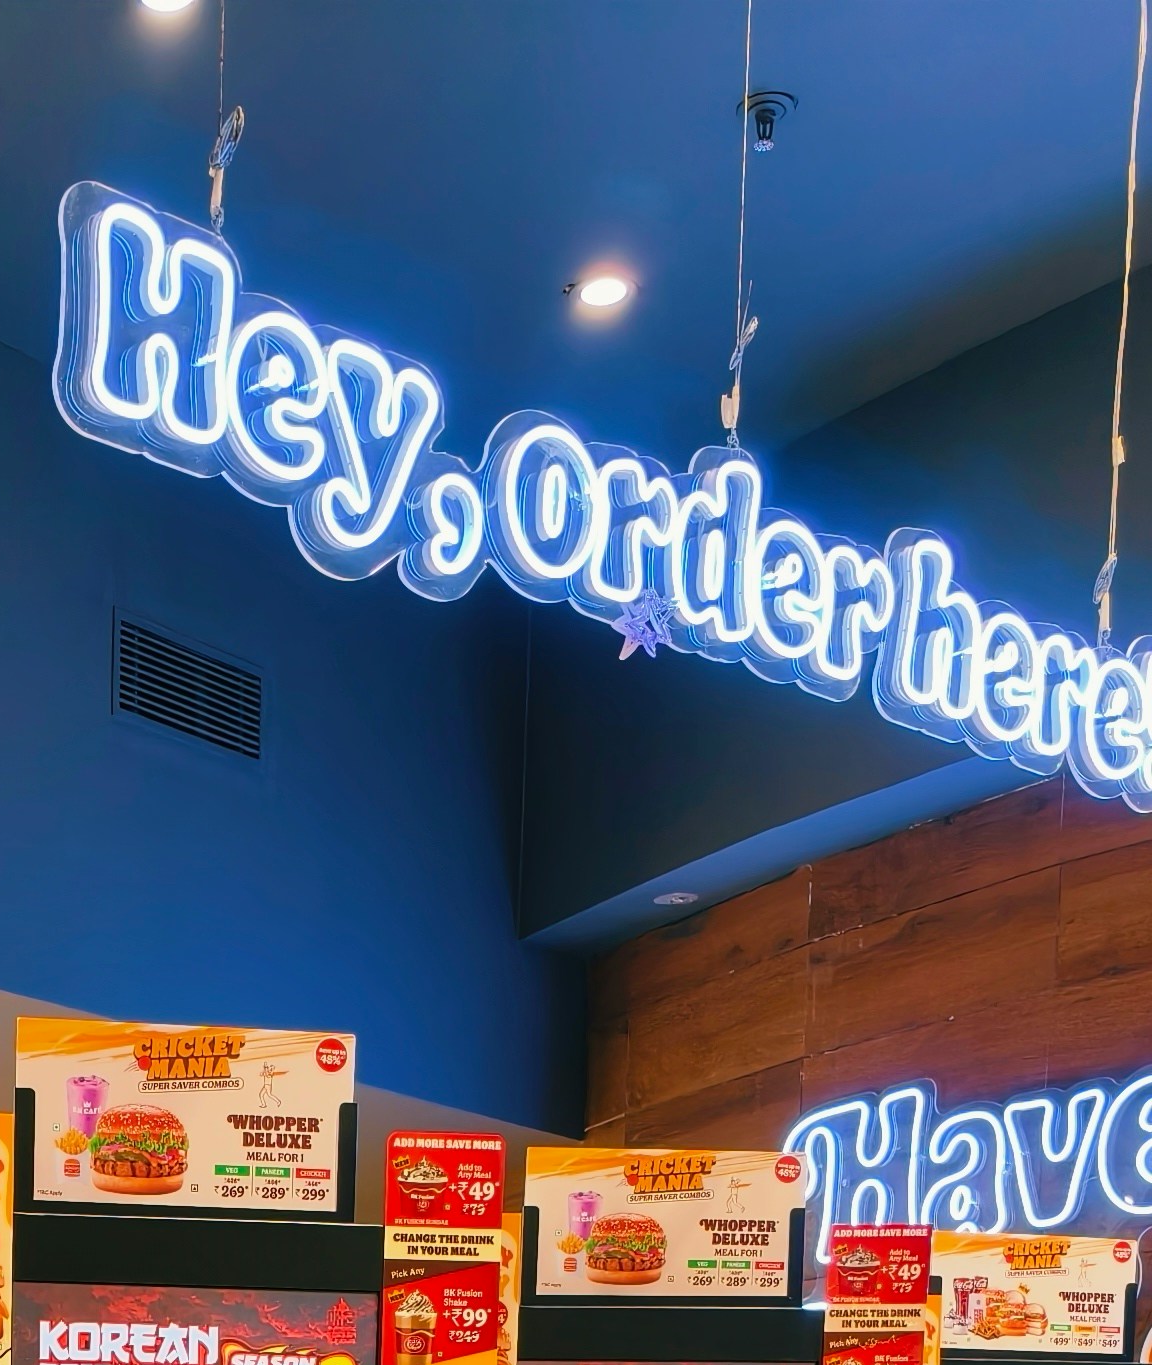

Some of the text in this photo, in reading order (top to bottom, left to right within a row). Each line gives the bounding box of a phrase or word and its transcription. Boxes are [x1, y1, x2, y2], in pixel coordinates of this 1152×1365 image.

[504, 423, 891, 683] Order
[904, 538, 1152, 790] here
[133, 1035, 246, 1059] CRICKET
[147, 1057, 231, 1081] MANIA
[142, 1079, 240, 1090] SUPER SAVER COMBOS
[227, 1114, 320, 1133] WHOPPER
[242, 1130, 312, 1150] DELUXE
[623, 1155, 716, 1177] CRICKET
[393, 1232, 494, 1245] CHANGE THE DRINK
[711, 1232, 769, 1246] DELUXE
[829, 1308, 921, 1318] CHANGE THE DRINK
[38, 1320, 220, 1365] KOREAN
